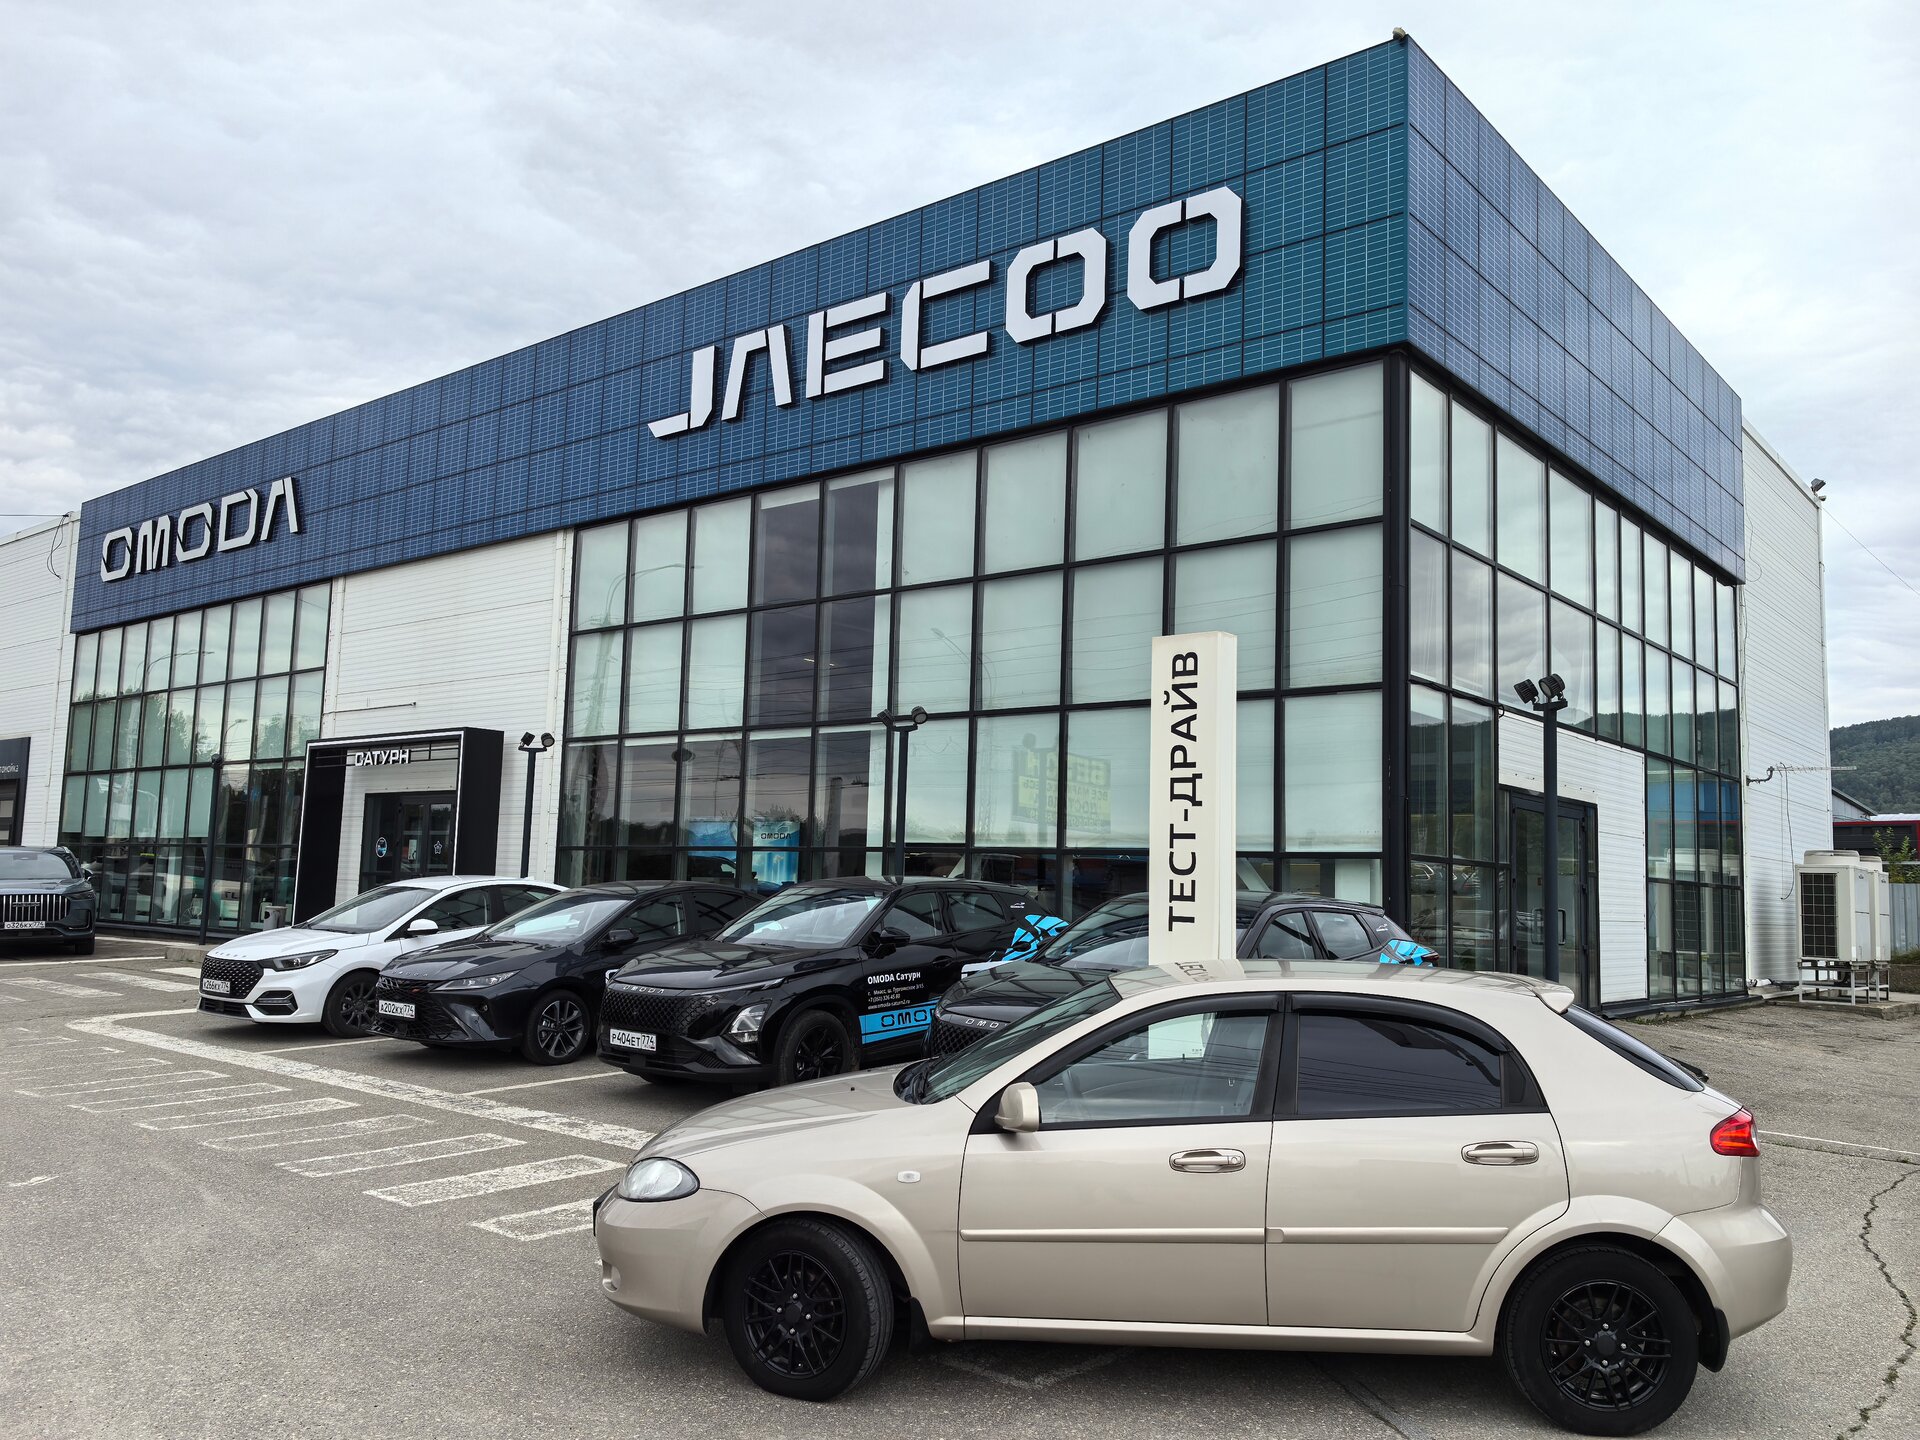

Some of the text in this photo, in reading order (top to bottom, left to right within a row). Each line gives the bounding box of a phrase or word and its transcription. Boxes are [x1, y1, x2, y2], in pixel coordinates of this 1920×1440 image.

[648, 187, 1241, 438] JAECOO
[100, 476, 299, 583] OMODA
[354, 748, 410, 766] САТУРН
[1163, 650, 1203, 932] ТЕСТ-ДРАЙВ
[867, 971, 921, 985] OMODA Сатурн
[623, 984, 665, 994] OMODA
[611, 1031, 654, 1047] Р404ЕТ 774
